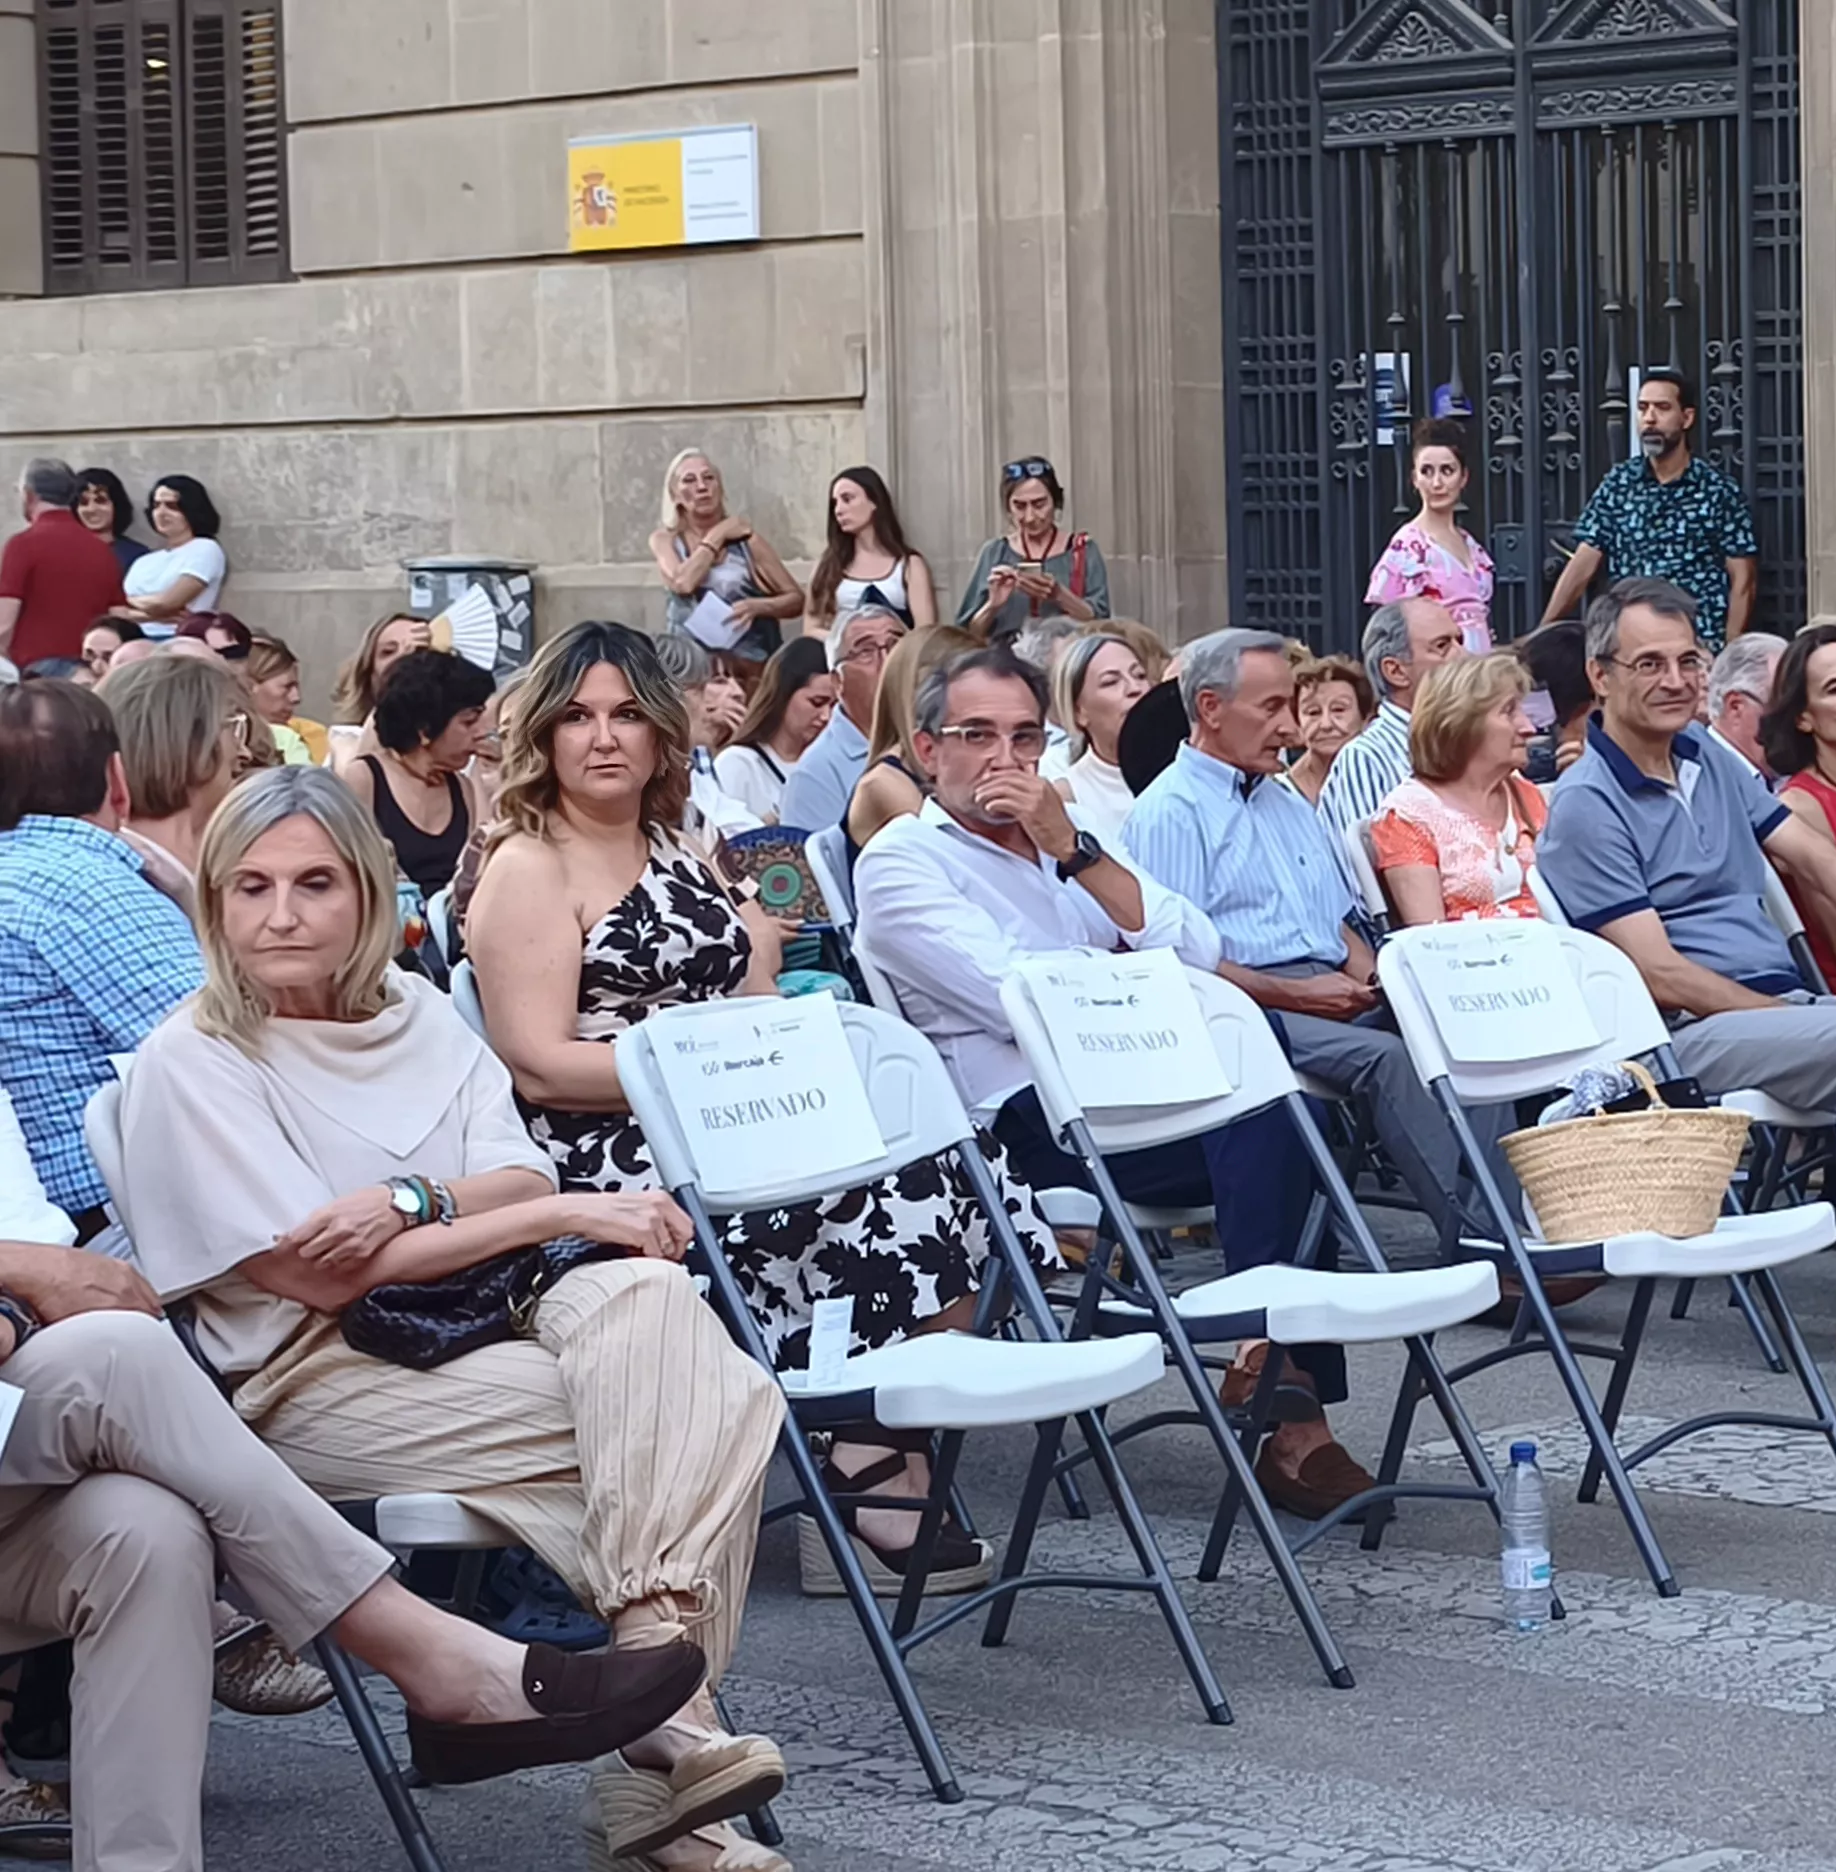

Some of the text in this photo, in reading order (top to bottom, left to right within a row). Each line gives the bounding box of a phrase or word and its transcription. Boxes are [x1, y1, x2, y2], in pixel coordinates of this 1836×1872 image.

[1447, 984, 1551, 1013] RESERVADO
[1076, 1028, 1179, 1052] RESERVADO
[699, 1087, 827, 1131] RESERVADO
